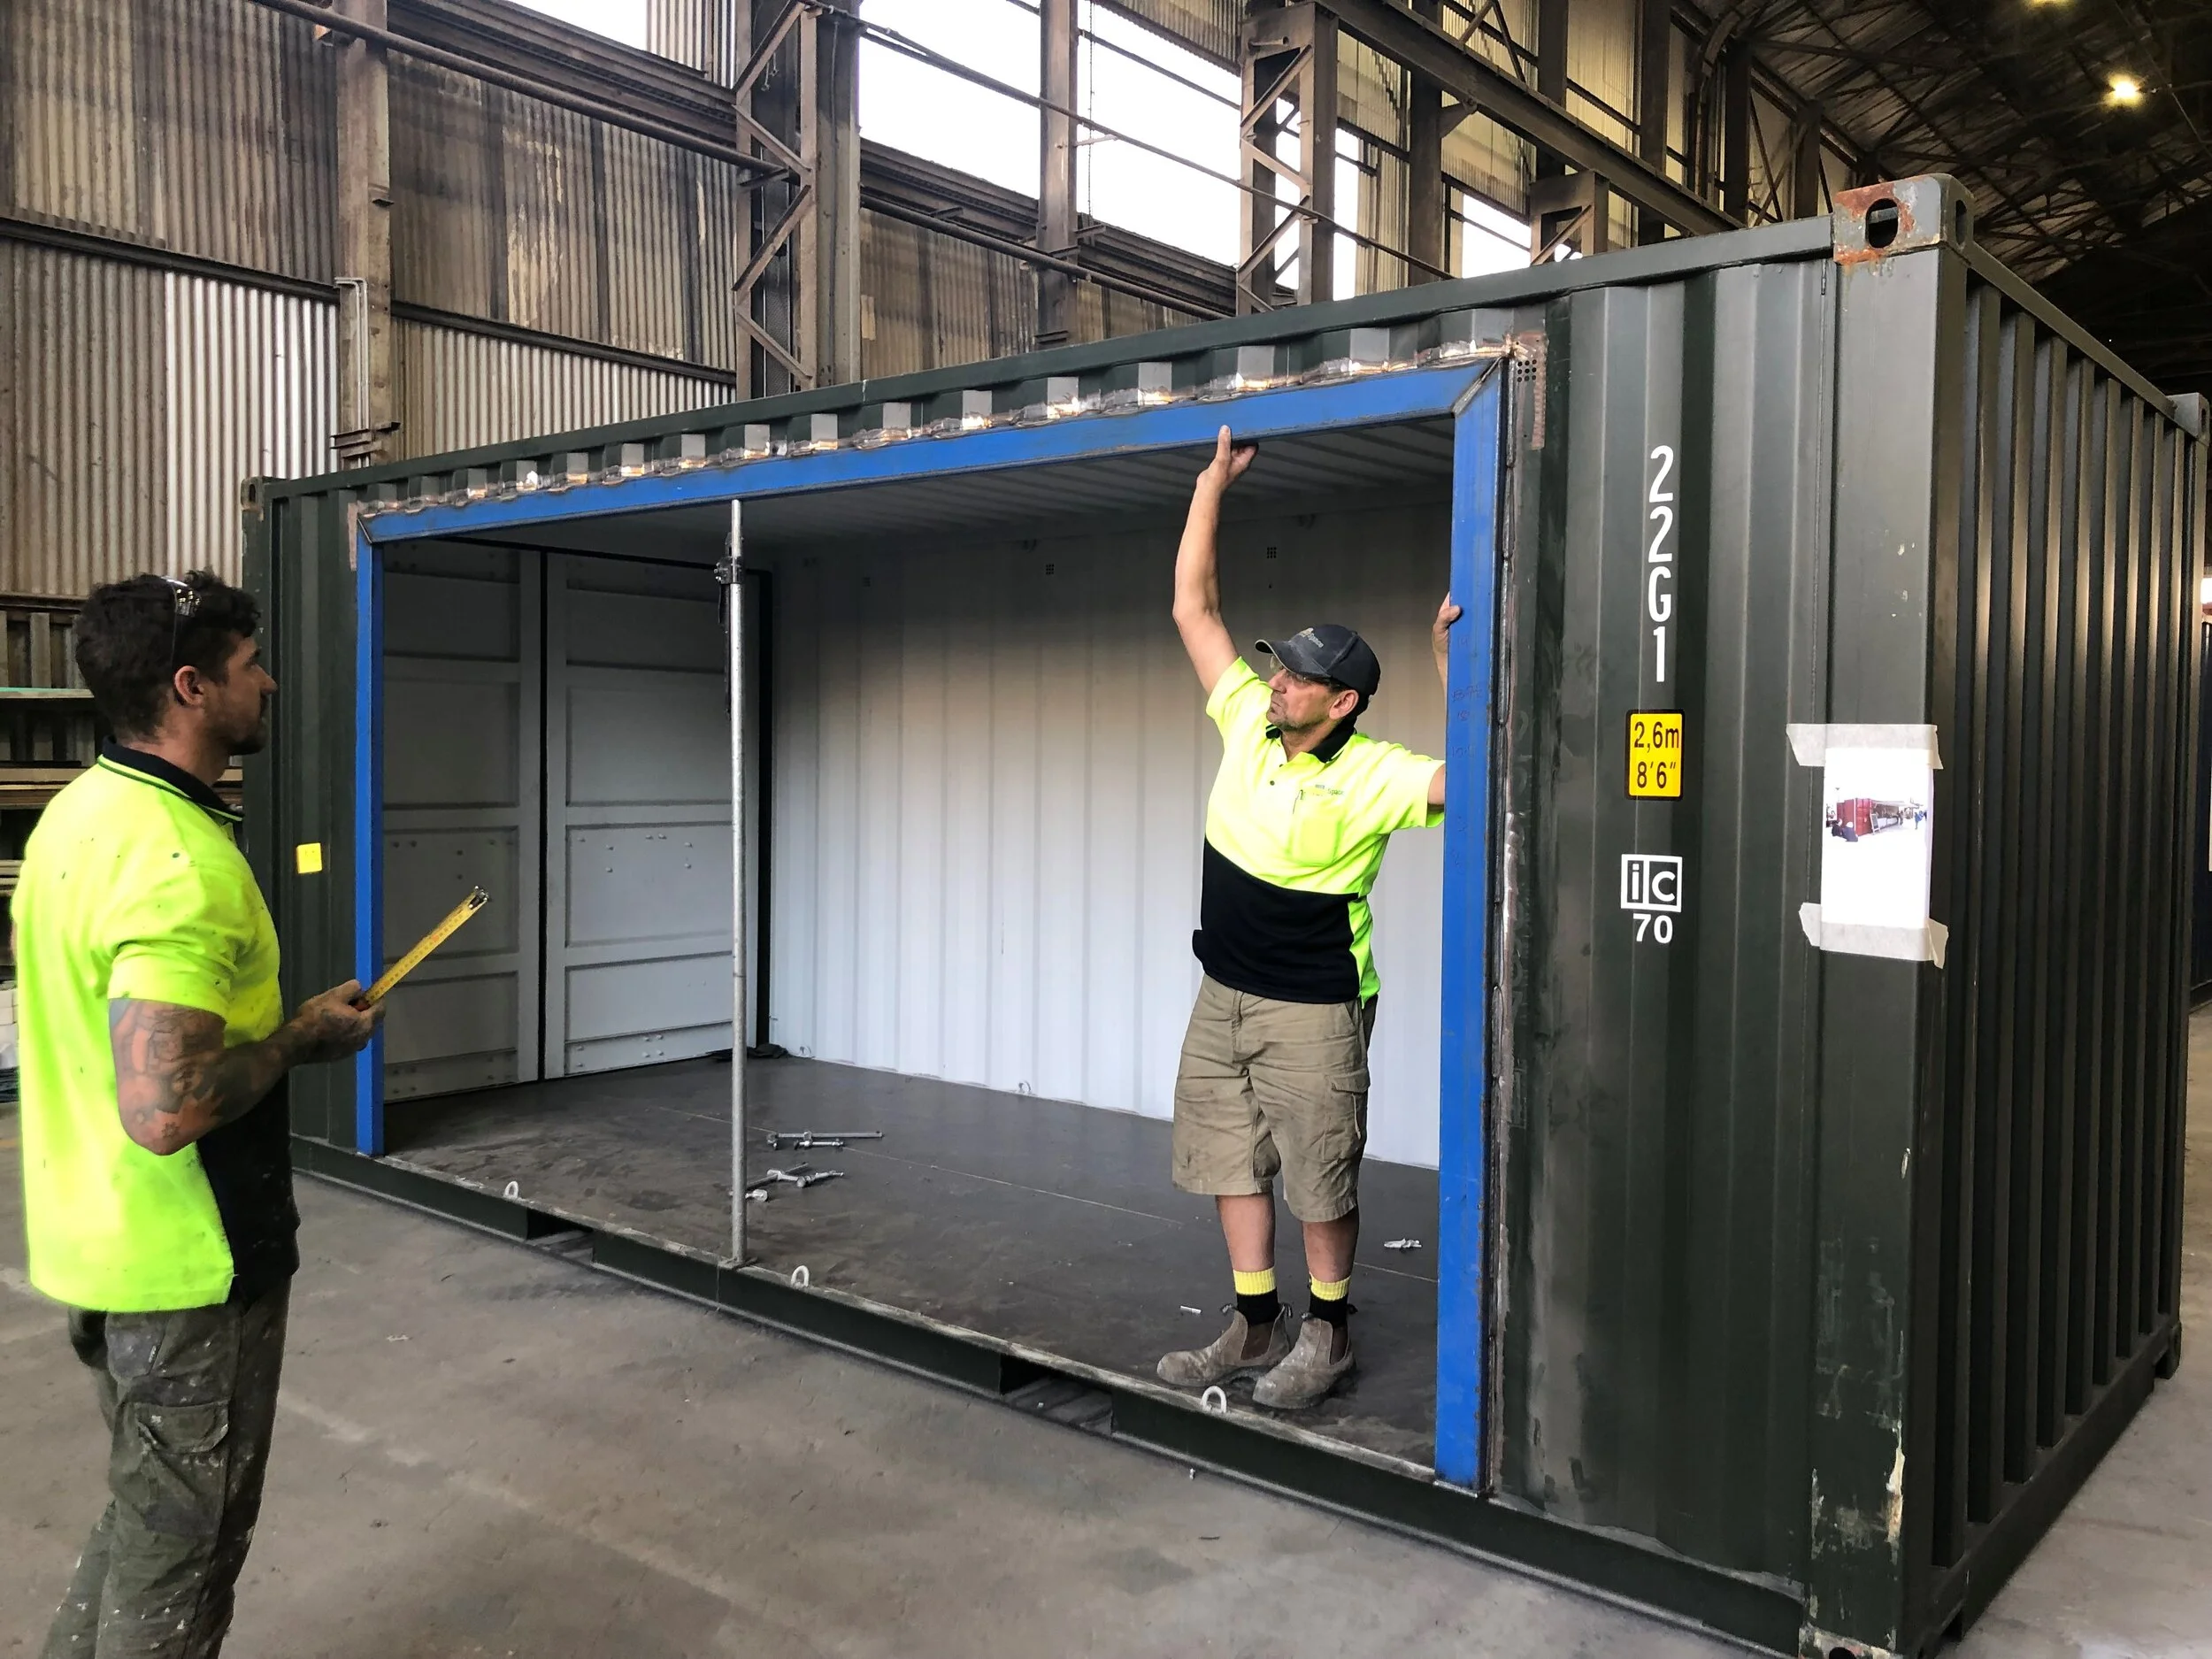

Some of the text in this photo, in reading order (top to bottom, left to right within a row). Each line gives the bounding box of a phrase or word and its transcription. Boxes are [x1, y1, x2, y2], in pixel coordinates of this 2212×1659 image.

[1647, 445, 1674, 682] 22G1
[1633, 721, 1679, 753] 2,6m
[1632, 913, 1673, 944] 70
